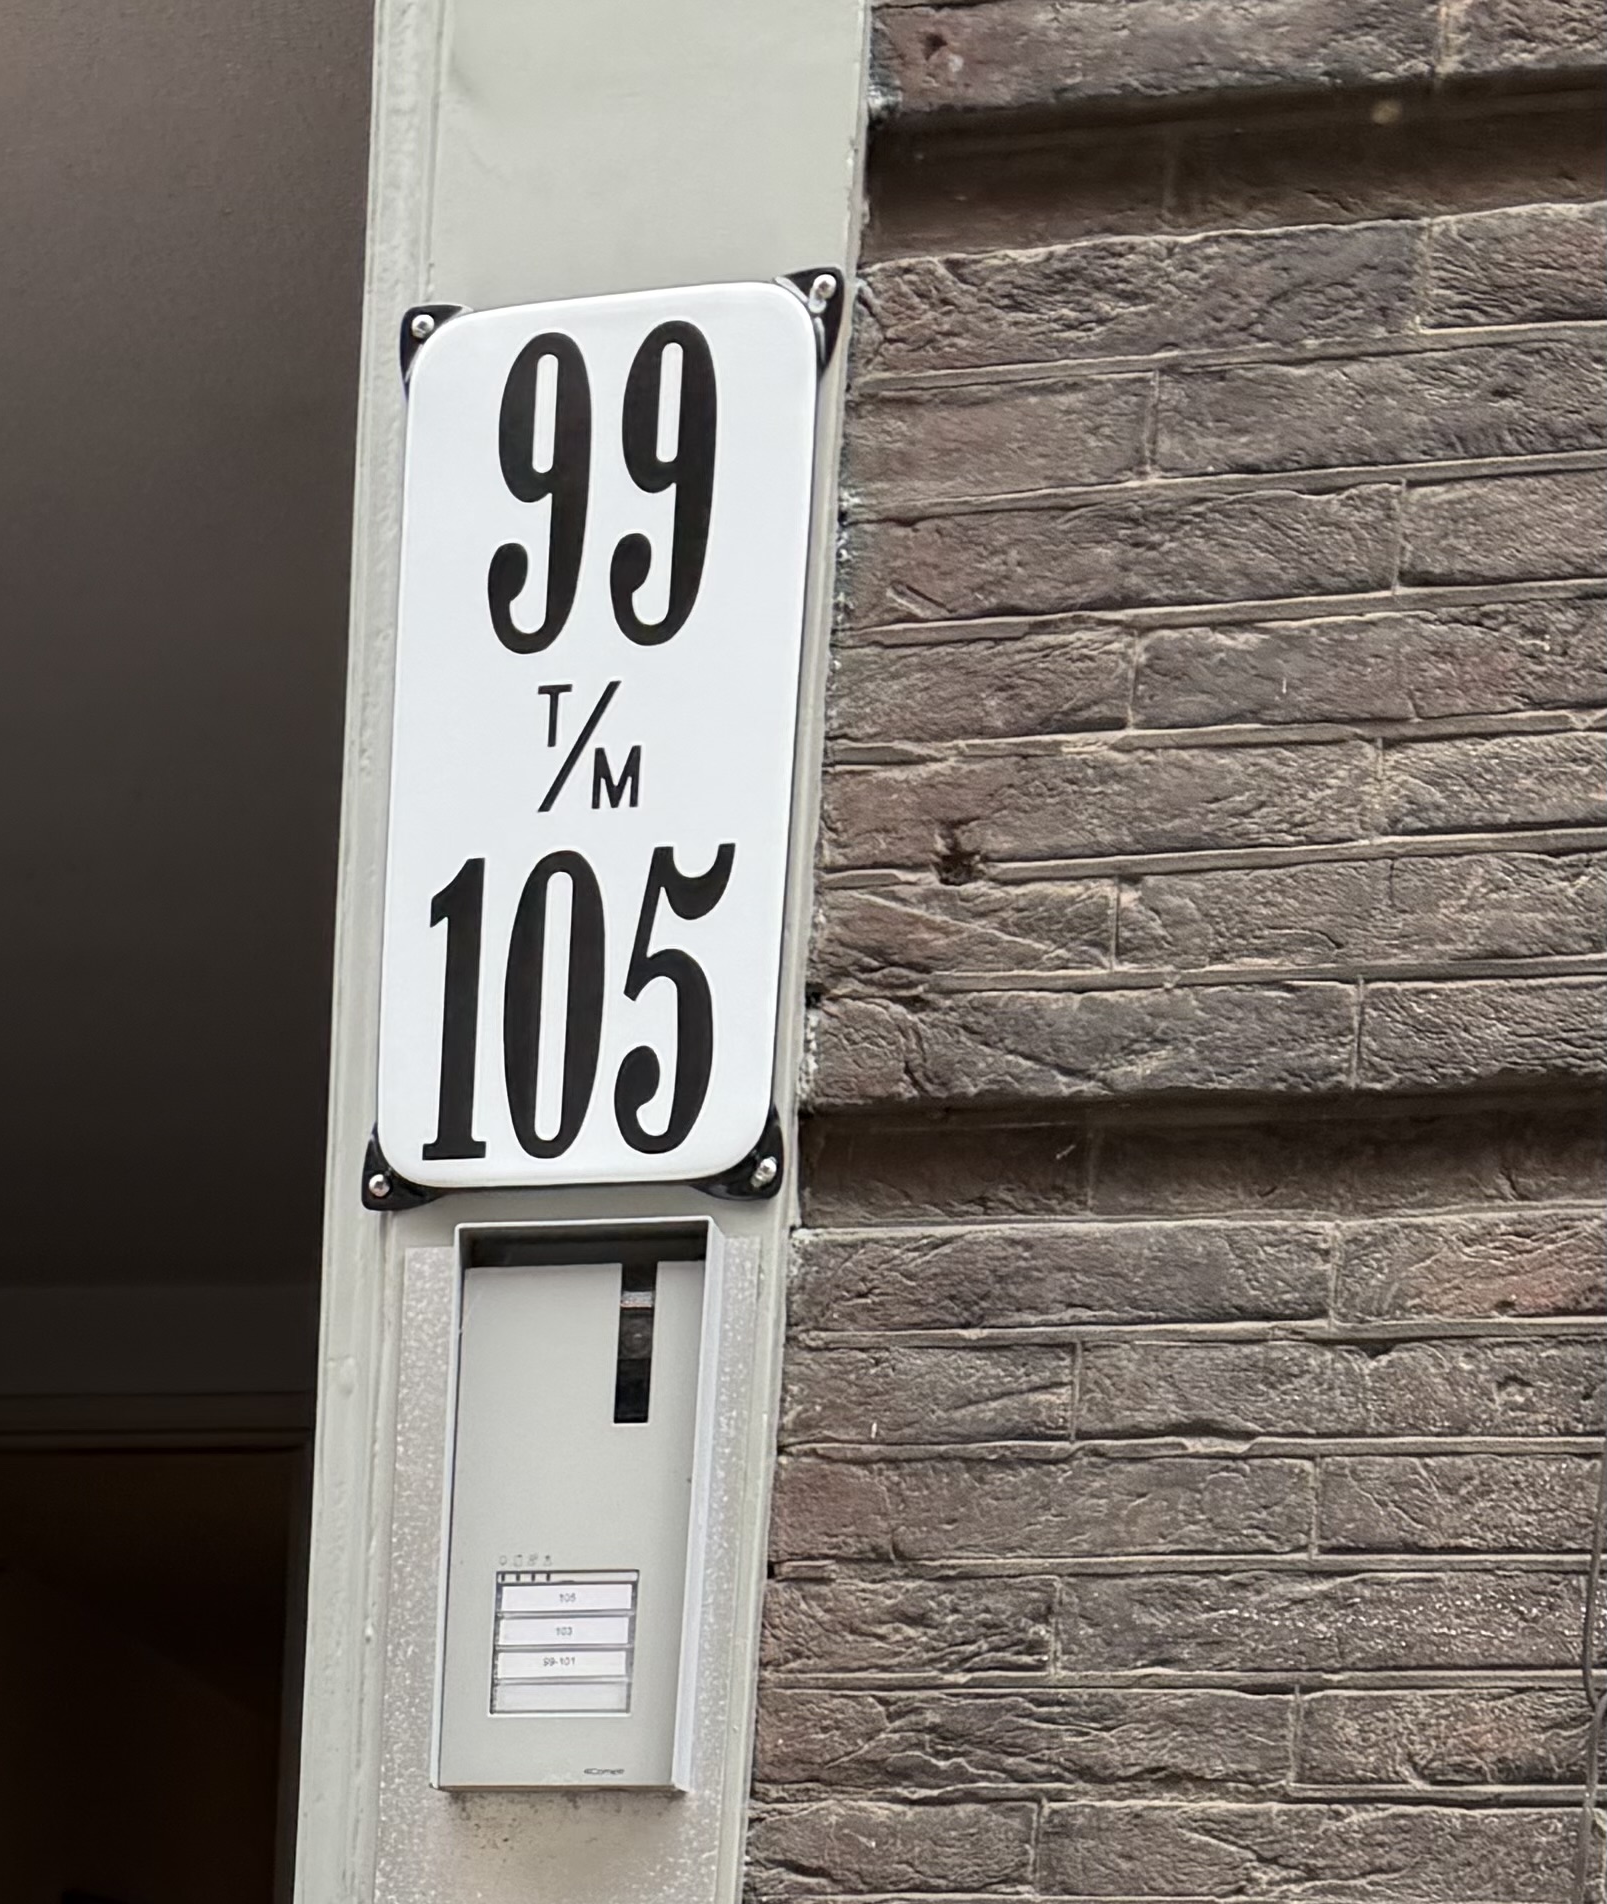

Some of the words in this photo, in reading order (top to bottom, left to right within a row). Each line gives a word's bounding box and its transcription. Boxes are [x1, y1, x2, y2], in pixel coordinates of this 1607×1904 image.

[487, 320, 717, 655] 99
[537, 680, 642, 813] T/M
[421, 842, 737, 1161] 105
